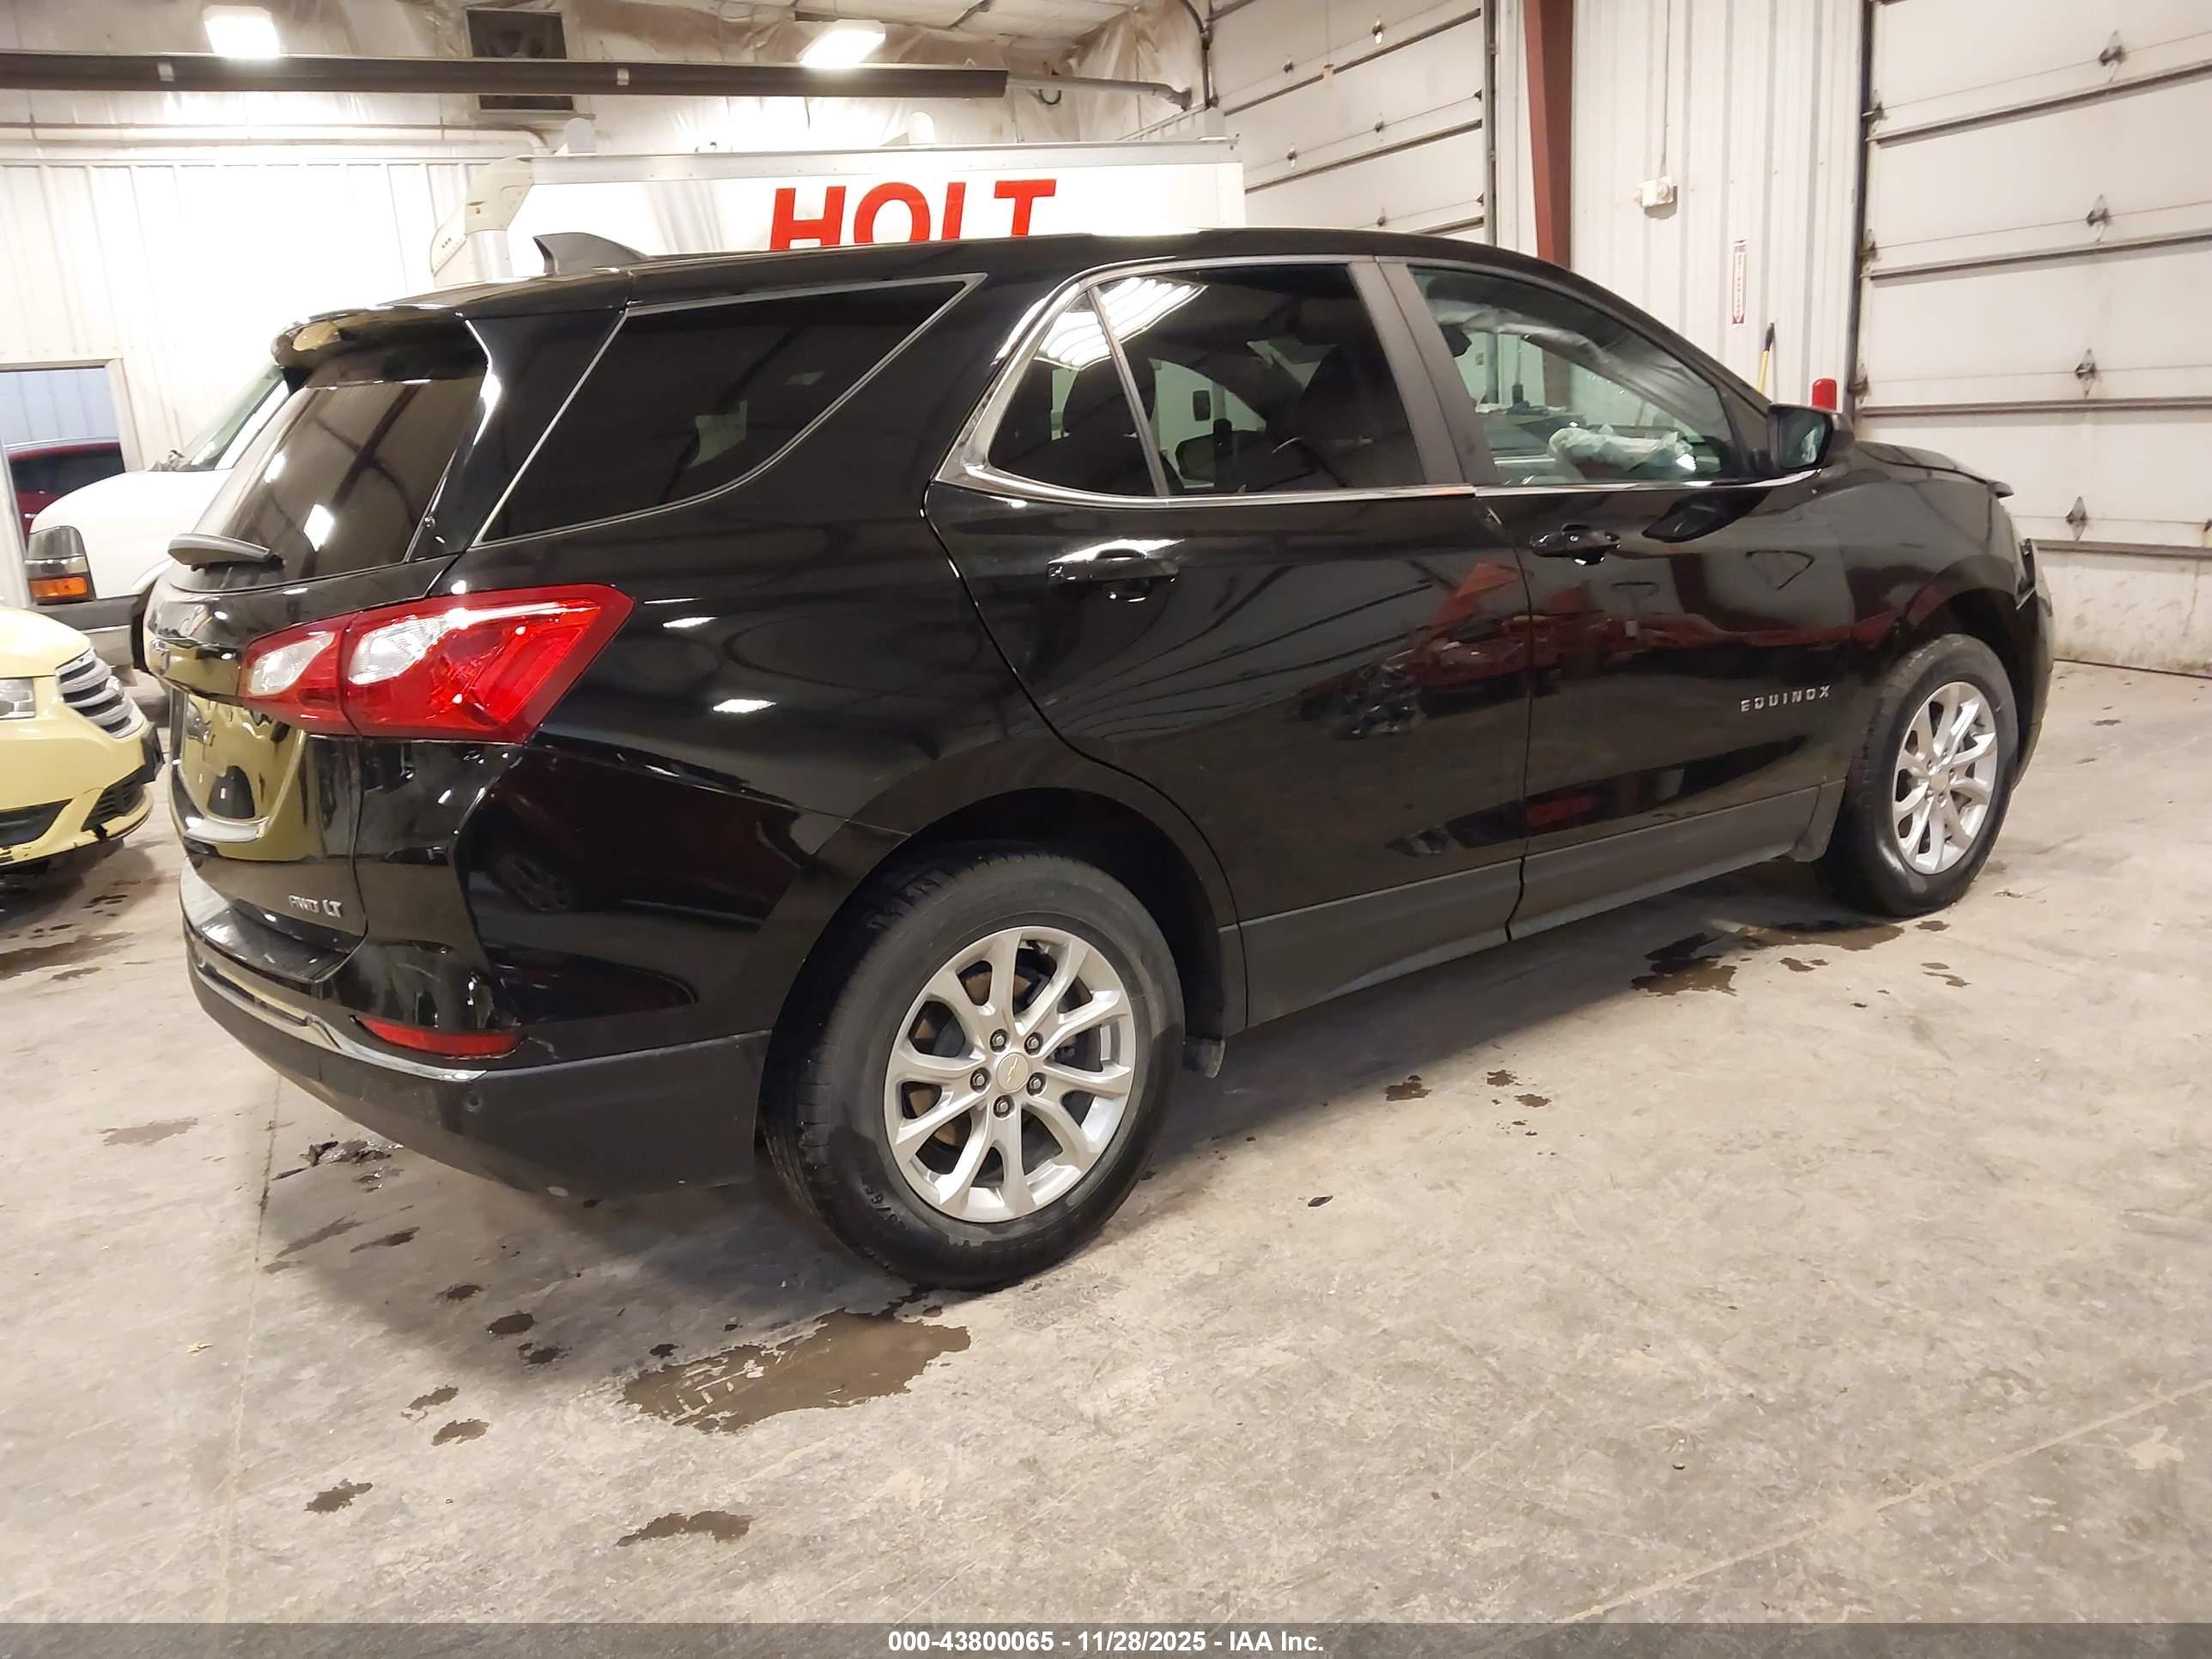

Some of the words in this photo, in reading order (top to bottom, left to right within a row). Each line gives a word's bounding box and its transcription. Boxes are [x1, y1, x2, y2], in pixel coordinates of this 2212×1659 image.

[1740, 684, 1832, 712] EQUINOX
[288, 894, 319, 914] AWD
[322, 899, 343, 919] LT
